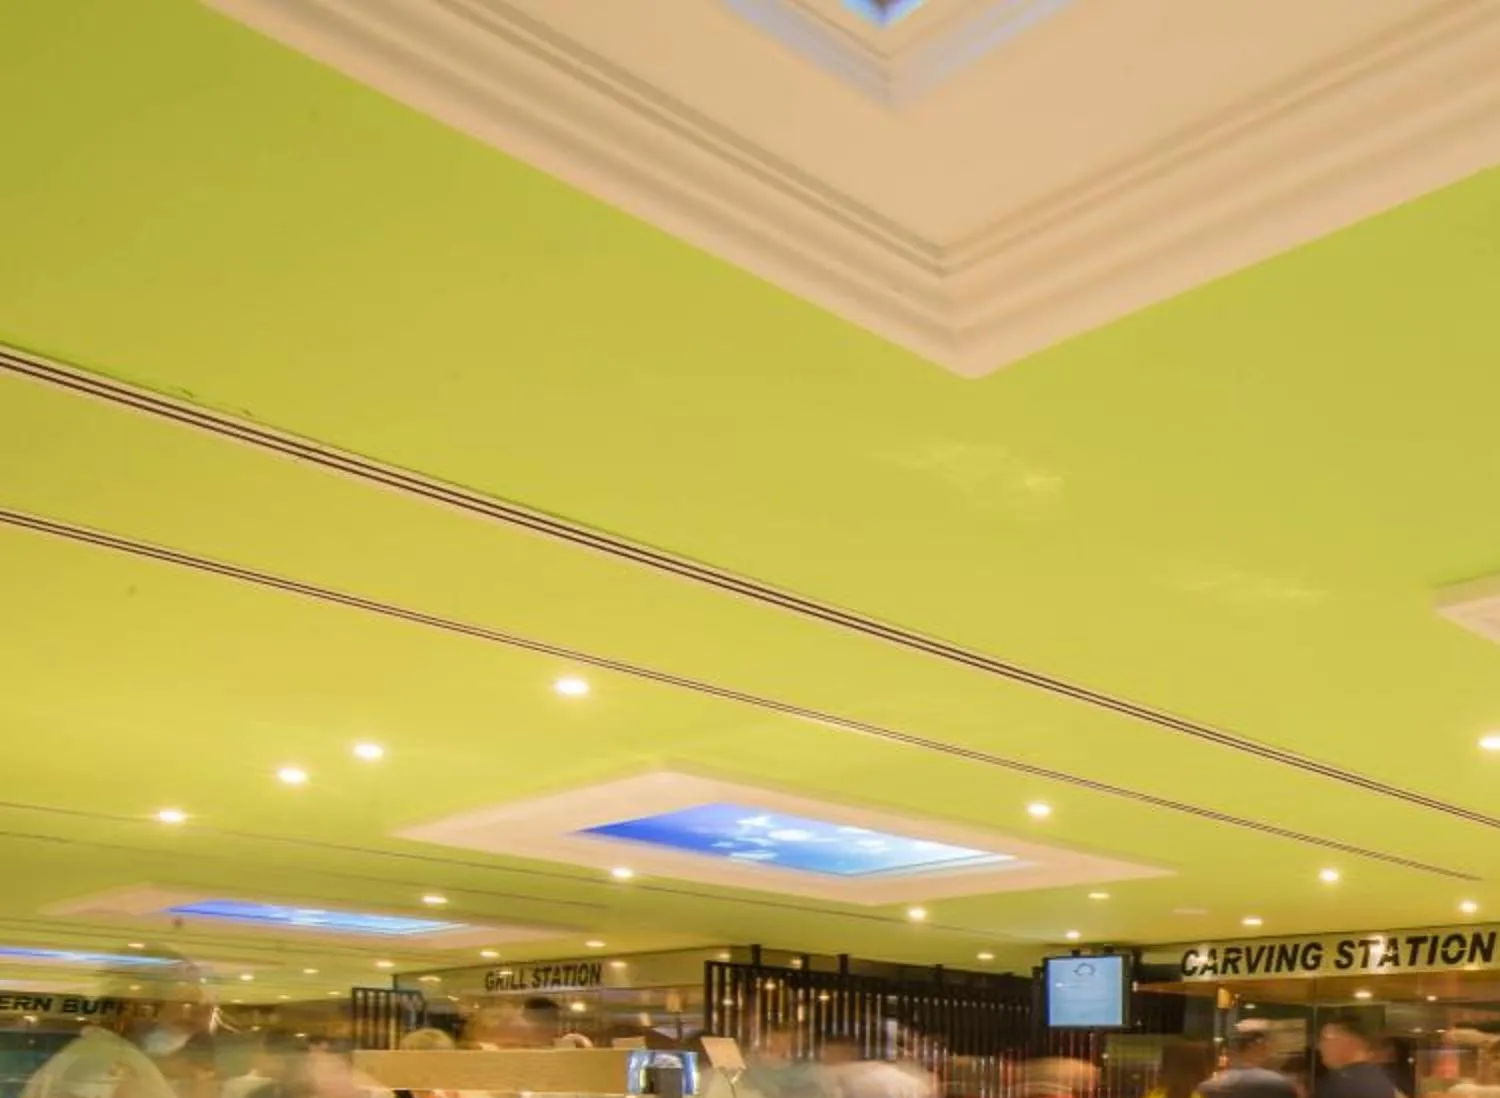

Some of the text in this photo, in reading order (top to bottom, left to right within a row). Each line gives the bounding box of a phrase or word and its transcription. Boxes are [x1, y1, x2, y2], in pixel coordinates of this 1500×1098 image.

[1181, 931, 1497, 976] CARVING STATION
[486, 961, 601, 991] GRILL STATION
